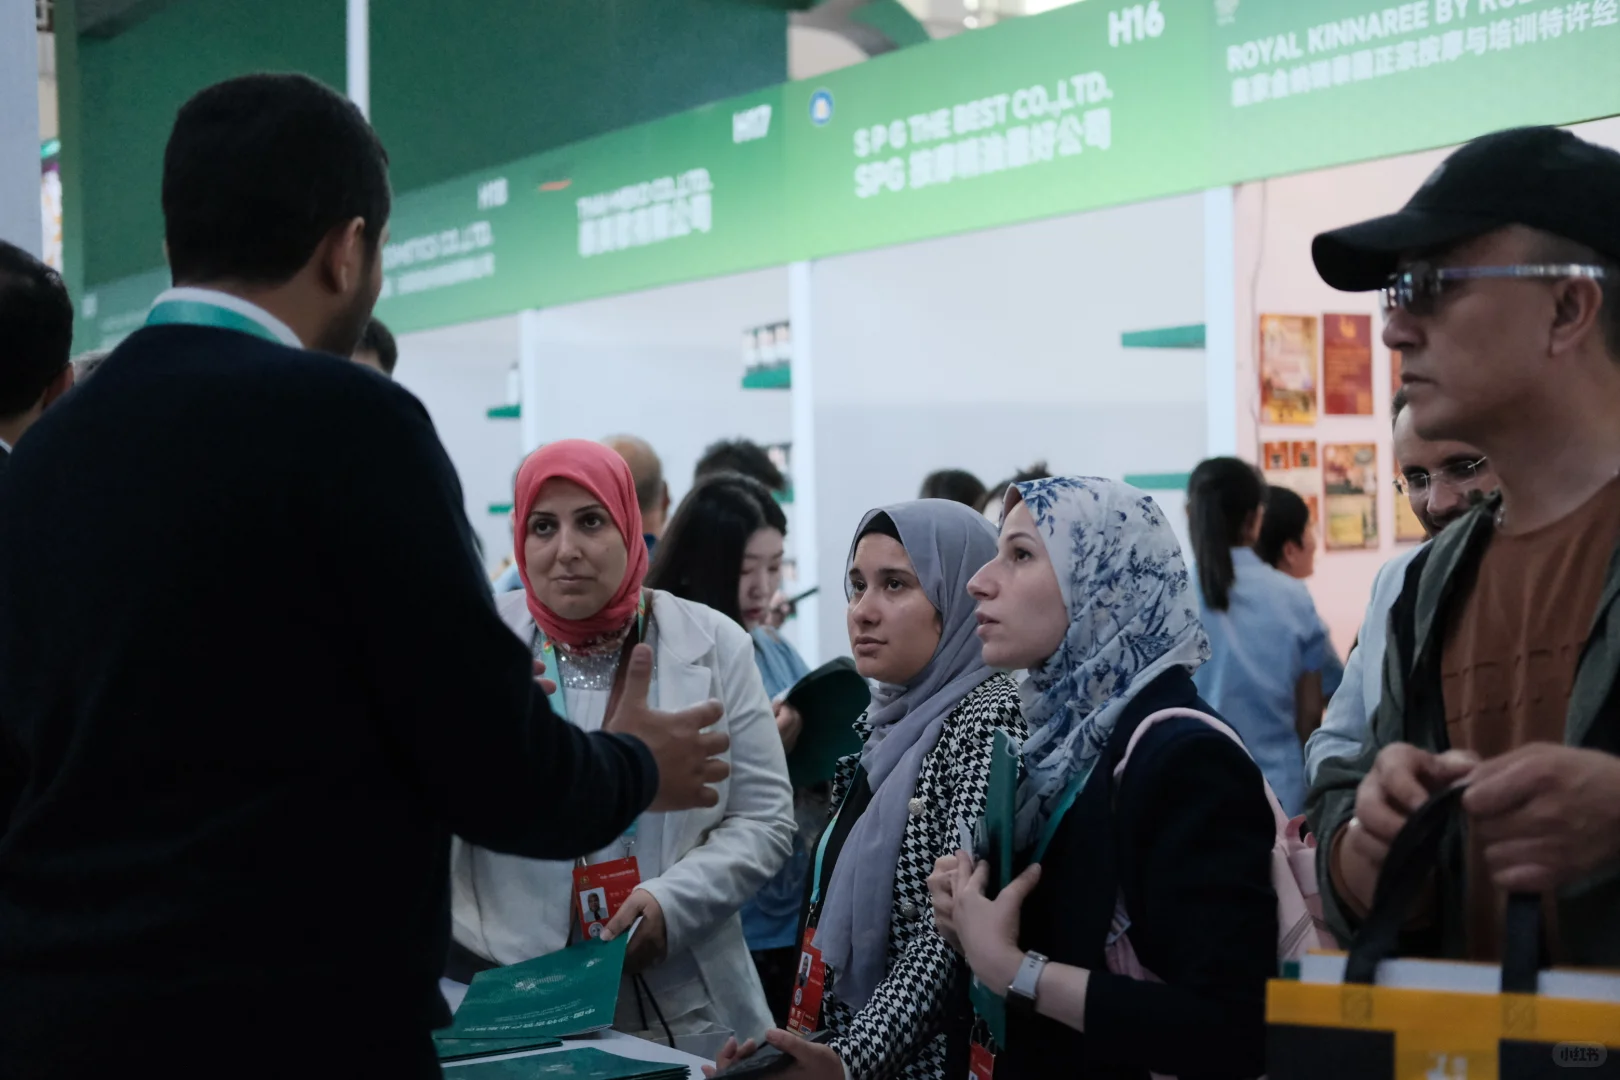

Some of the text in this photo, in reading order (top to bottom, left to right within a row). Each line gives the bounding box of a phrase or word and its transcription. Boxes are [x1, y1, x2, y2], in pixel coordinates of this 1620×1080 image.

[1107, 1, 1166, 47] H16
[1226, 0, 1468, 73] ROYAL KINNAREE BY
[907, 108, 951, 143] THE
[952, 93, 1010, 135] BEST
[854, 157, 906, 198] SPG
